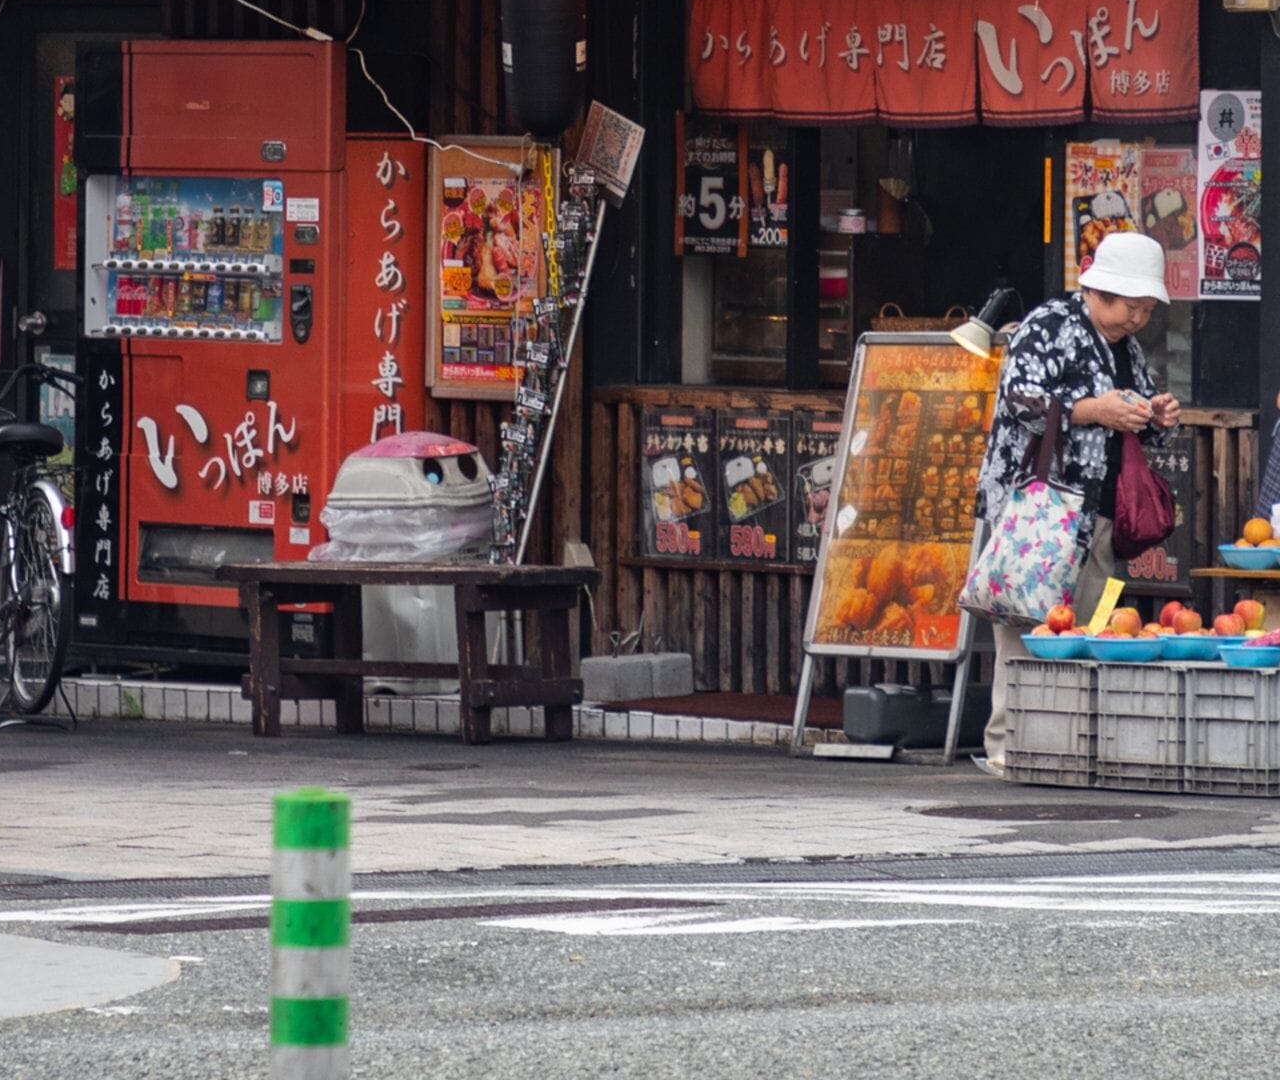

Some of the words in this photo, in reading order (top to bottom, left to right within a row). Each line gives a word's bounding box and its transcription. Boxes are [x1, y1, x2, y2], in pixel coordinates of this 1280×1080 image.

[1110, 70, 1171, 94] 博多店
[137, 401, 296, 490] いっぽん
[93, 369, 115, 601] からあげ専門店
[257, 471, 308, 496] 博多店
